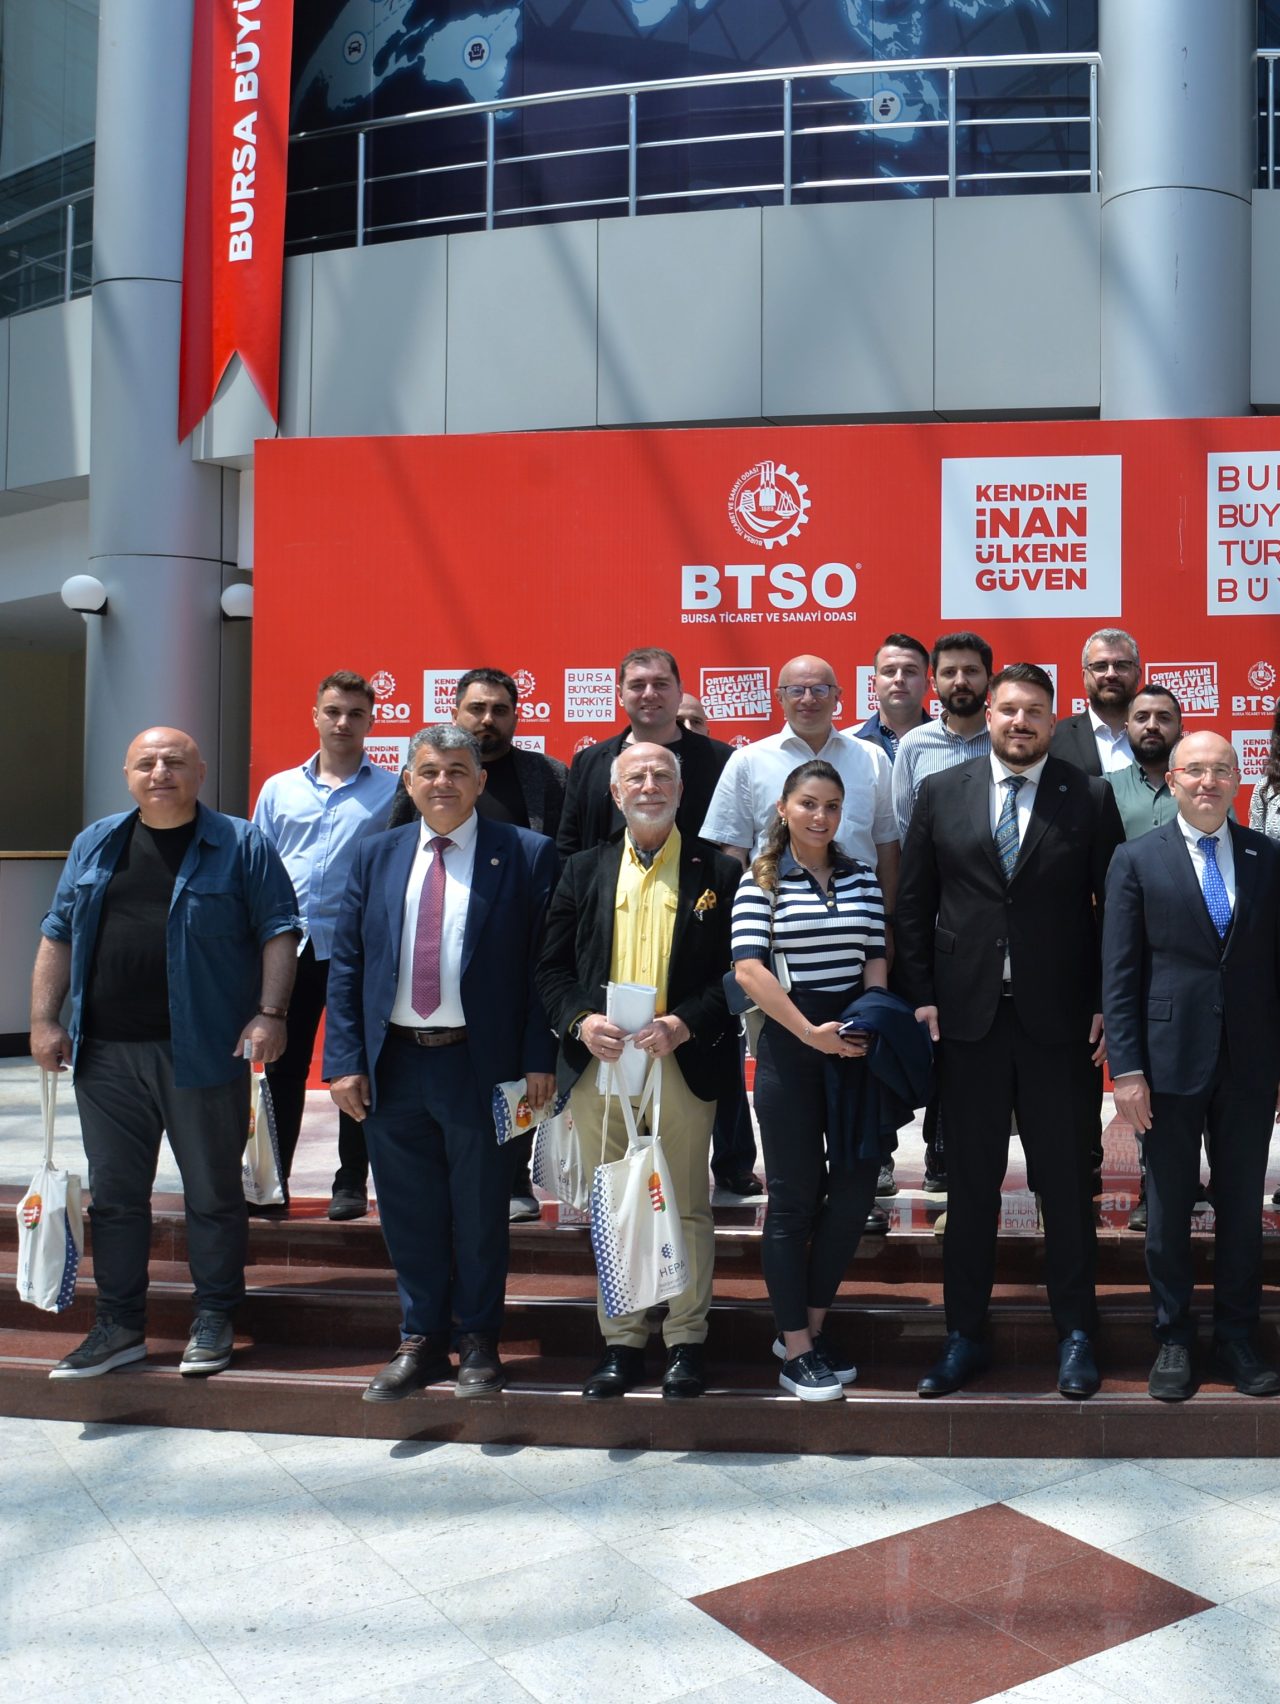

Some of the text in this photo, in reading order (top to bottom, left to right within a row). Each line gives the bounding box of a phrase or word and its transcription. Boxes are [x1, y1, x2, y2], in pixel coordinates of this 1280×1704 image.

[228, 112, 258, 261] BURSA
[975, 543, 1087, 564] ÜLKENE
[681, 562, 857, 610] BTSO
[975, 567, 1087, 592] GÜVEN
[681, 610, 857, 624] BURSA TİCARET VE SANAYİ ODASI
[568, 673, 612, 682] BURSA
[706, 672, 763, 686] ORTAK AKLIN
[1151, 667, 1210, 681] ORTAK AKLIN
[435, 686, 457, 697] İNA
[568, 685, 612, 694] BÜYÜRSE
[515, 702, 550, 719] SO
[1232, 695, 1280, 712] BTS
[372, 703, 411, 719] TSO
[567, 709, 612, 718] BÜYÜR
[514, 740, 541, 750] RSA
[369, 754, 399, 764] NAN
[1243, 747, 1270, 758] İNA
